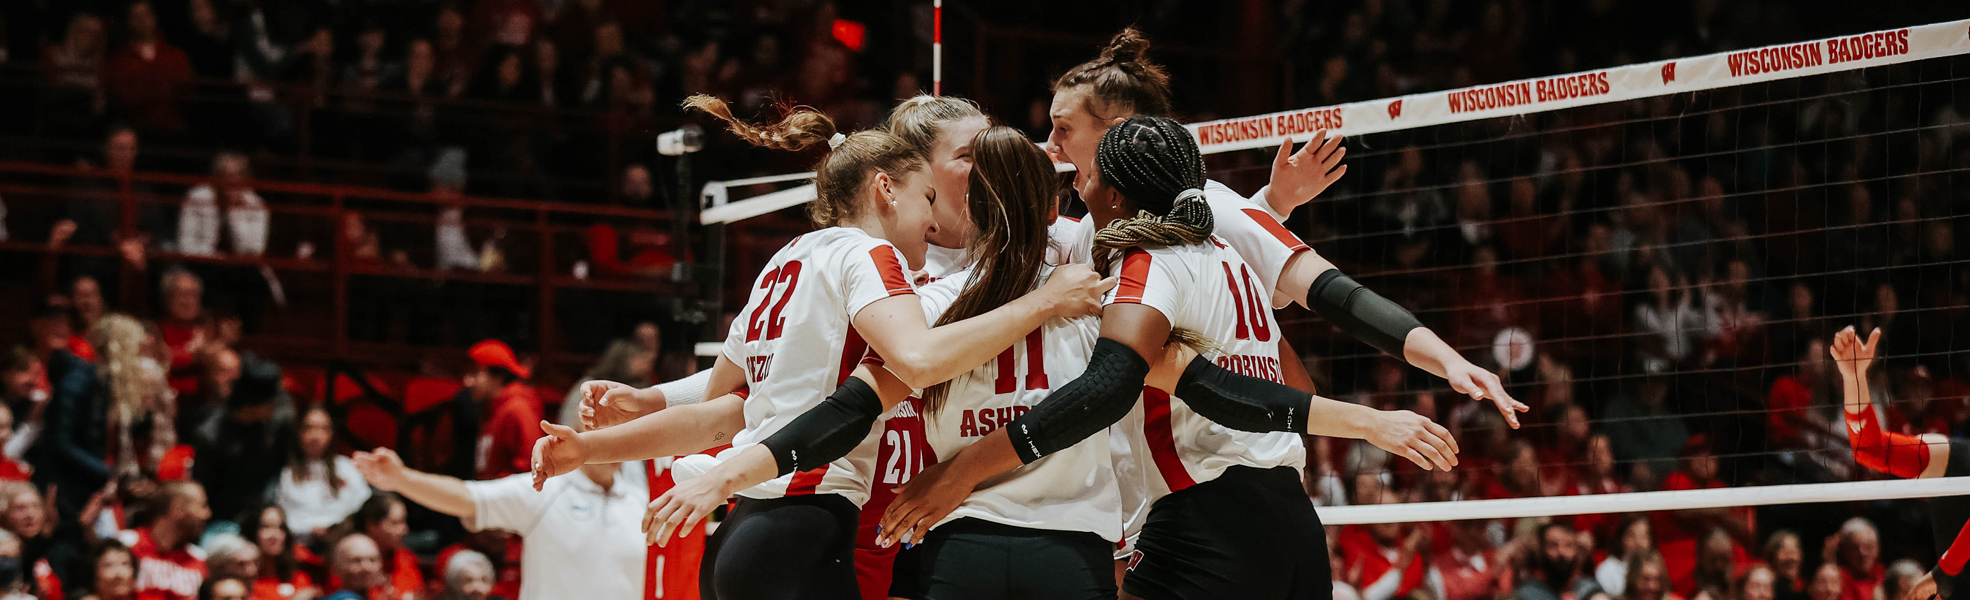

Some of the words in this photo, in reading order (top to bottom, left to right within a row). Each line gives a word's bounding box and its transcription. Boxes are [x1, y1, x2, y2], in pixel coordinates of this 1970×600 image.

[1661, 62, 1677, 85] W
[1727, 41, 1823, 78] WISCONSIN
[1826, 29, 1909, 64] BADGERS
[1387, 99, 1403, 121] W
[1447, 81, 1532, 114] WISCONSIN
[1536, 71, 1610, 103] BADGERS
[1198, 116, 1274, 146] WISCONSIN
[1276, 107, 1343, 136] BADGERS
[745, 260, 803, 344] 22
[1222, 260, 1271, 342] 10
[995, 326, 1050, 395] 11
[882, 429, 912, 485] 21
